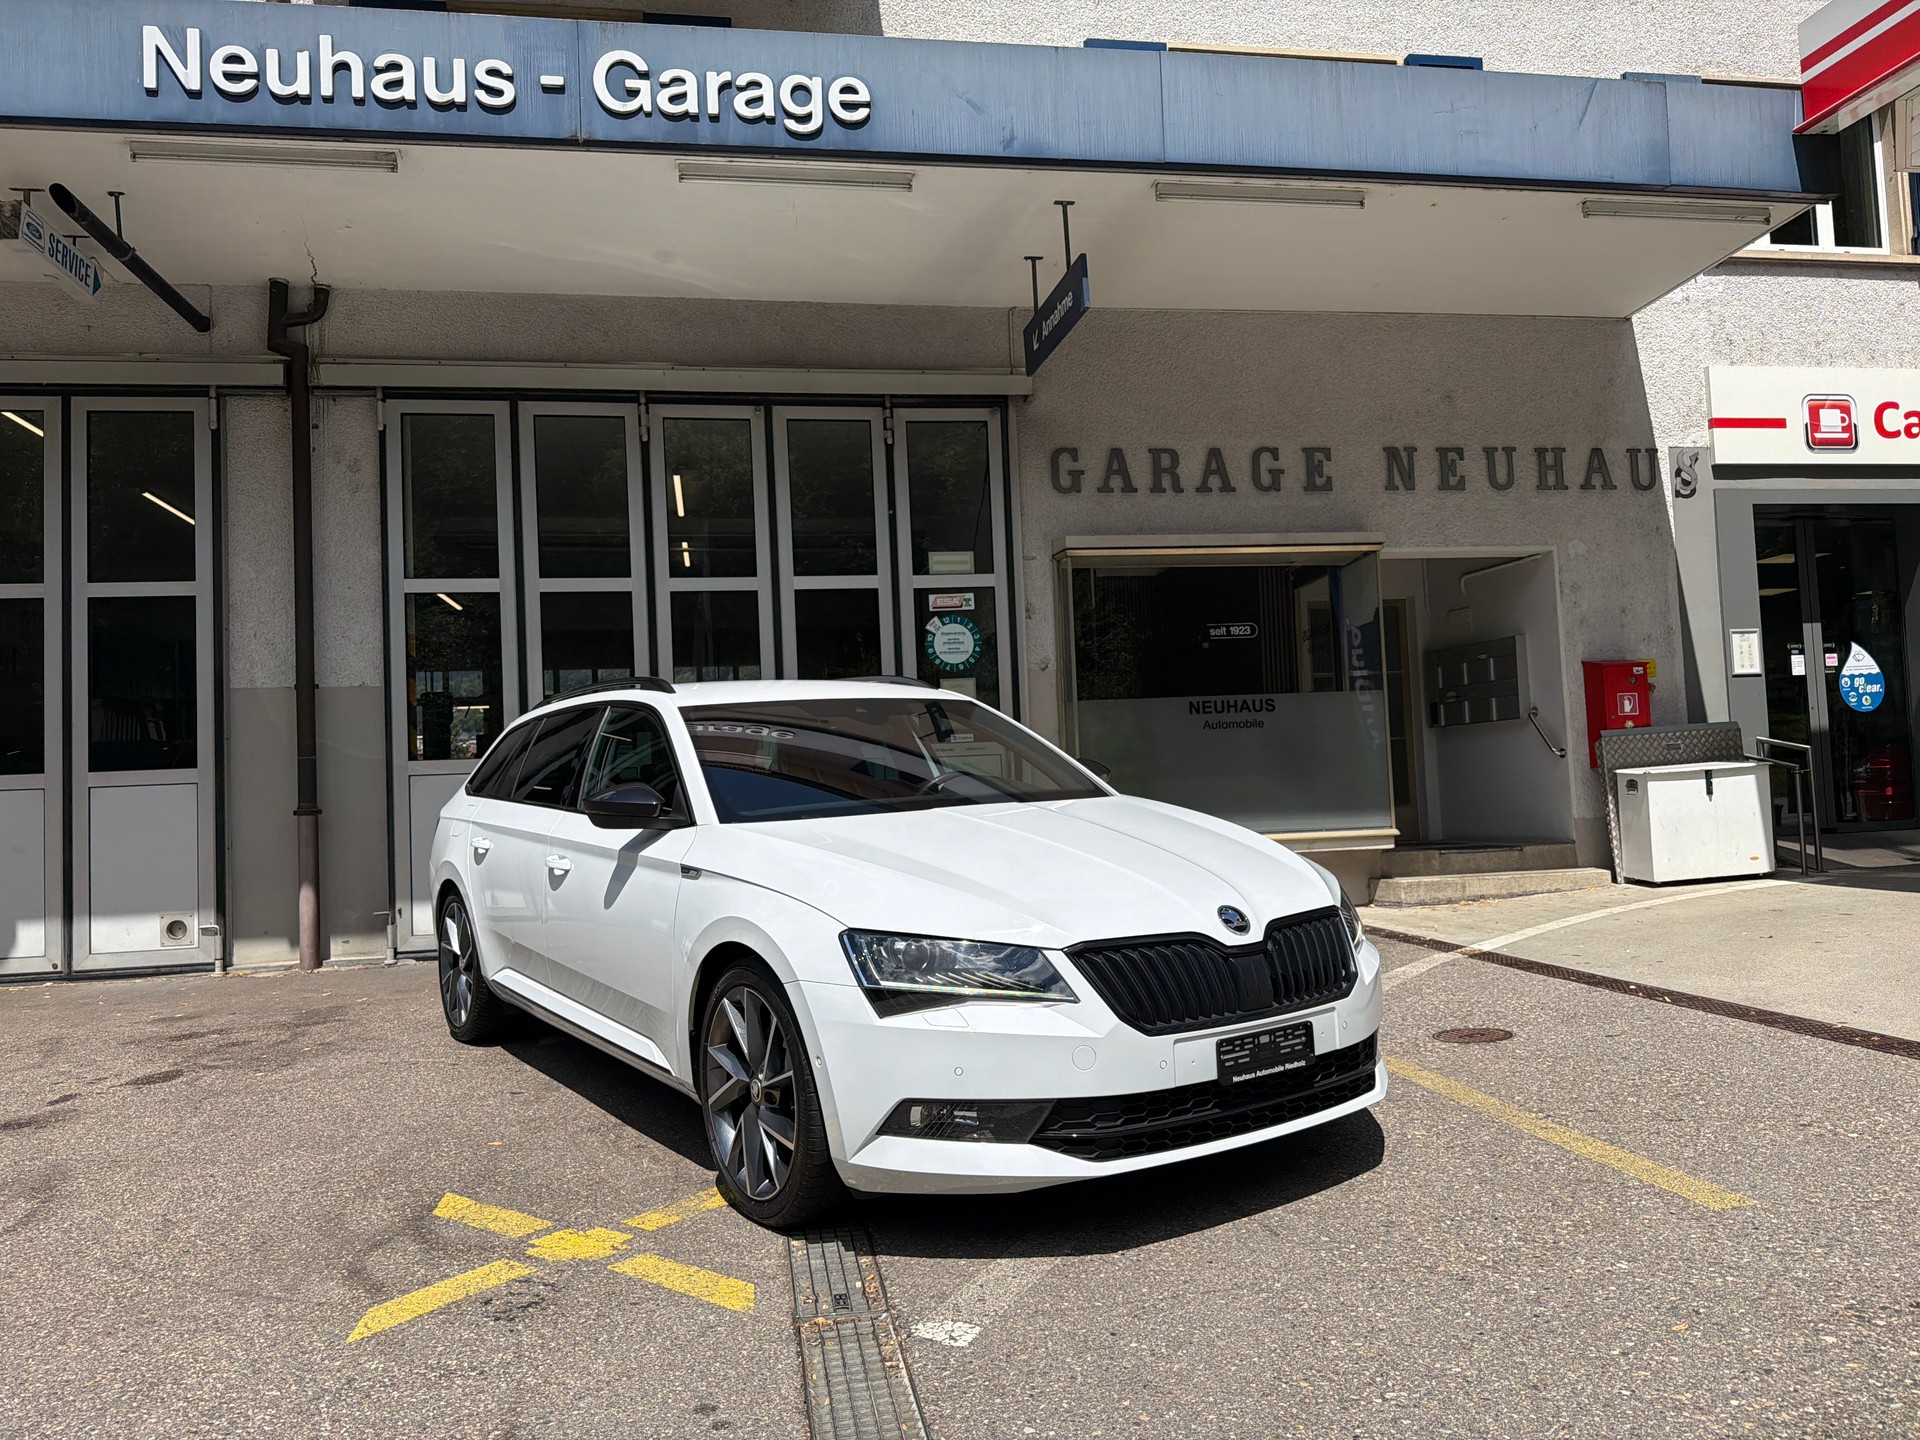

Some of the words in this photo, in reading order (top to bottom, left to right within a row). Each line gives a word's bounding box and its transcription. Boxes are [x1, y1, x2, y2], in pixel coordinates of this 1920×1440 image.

[143, 25, 516, 108] Neuhaus
[593, 50, 870, 135] Garage
[48, 232, 91, 288] SERVICE
[1042, 291, 1073, 340] Annahme
[1051, 447, 1333, 493] GARAGE
[1383, 447, 1698, 496] NEUHAUS
[1210, 626, 1227, 636] seit
[1229, 626, 1251, 636] 1923
[1854, 677, 1865, 687] go
[1188, 698, 1277, 715] NEUHAUS
[1203, 719, 1264, 730] Automobile
[1232, 1071, 1256, 1083] Neuhaus
[1256, 1064, 1284, 1077] Automobile
[1284, 1060, 1306, 1071] Riedholz
